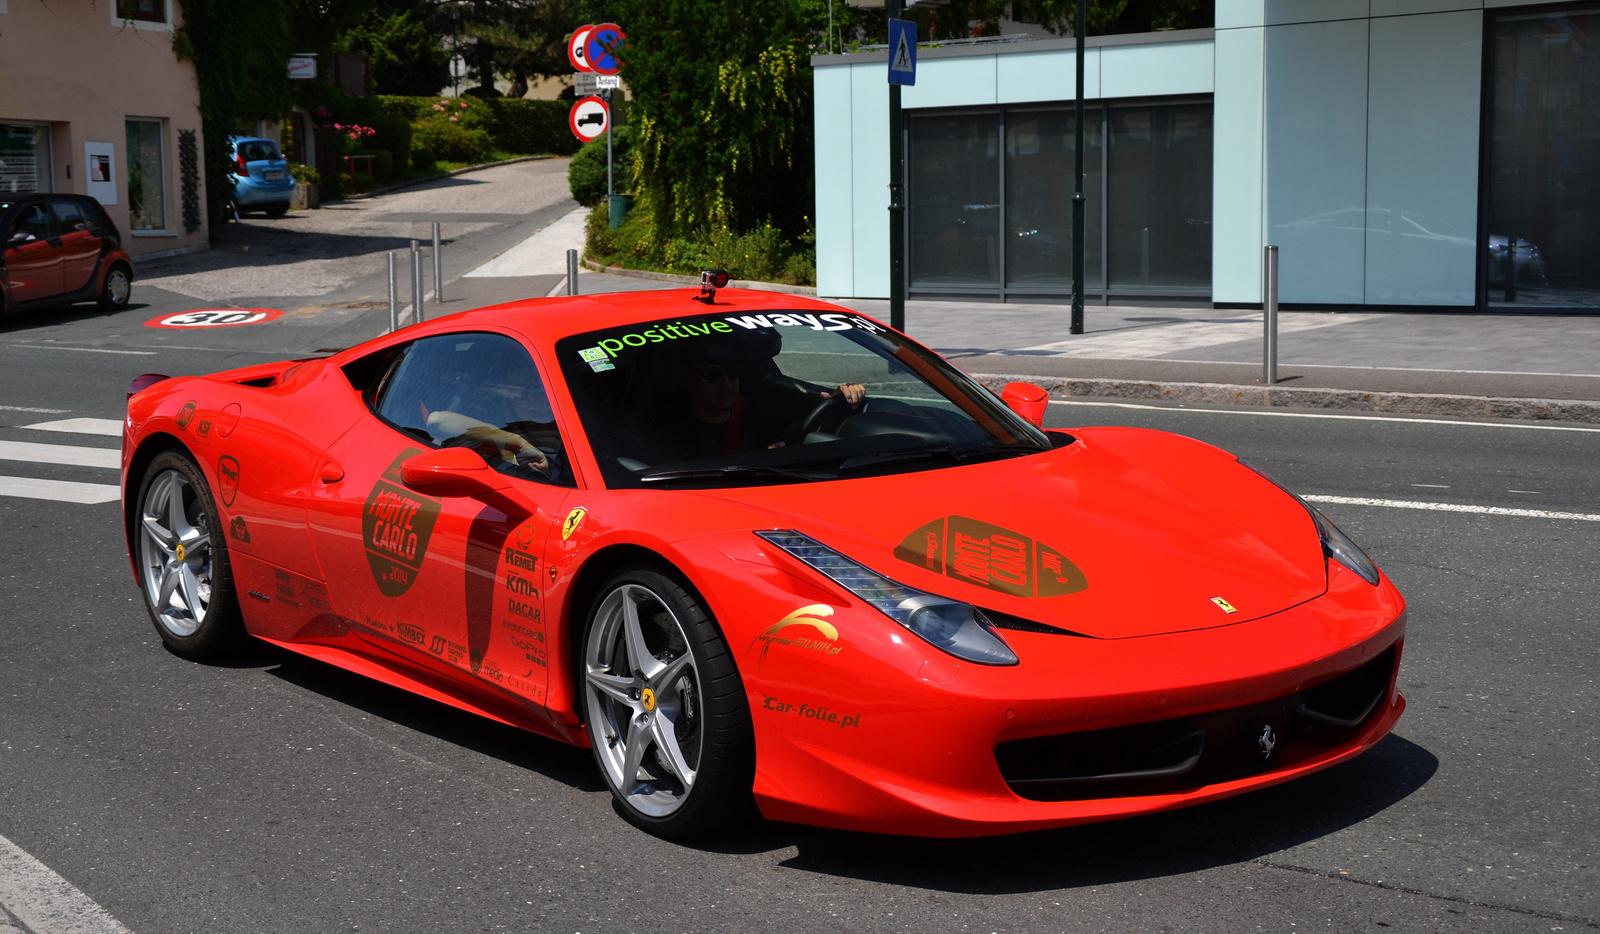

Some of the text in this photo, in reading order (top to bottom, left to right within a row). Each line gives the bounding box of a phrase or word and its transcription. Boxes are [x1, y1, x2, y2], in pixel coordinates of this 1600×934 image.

[598, 76, 618, 87] Anfang
[170, 312, 257, 324] 30
[368, 488, 422, 531] MONTE
[372, 519, 418, 561] CARLO
[954, 531, 990, 586] MONTE
[990, 534, 1027, 586] CARLO
[1041, 551, 1063, 575] 2014
[388, 565, 409, 585] 2014
[508, 598, 541, 623] DACAR
[763, 695, 861, 729] Car-folie.pl
